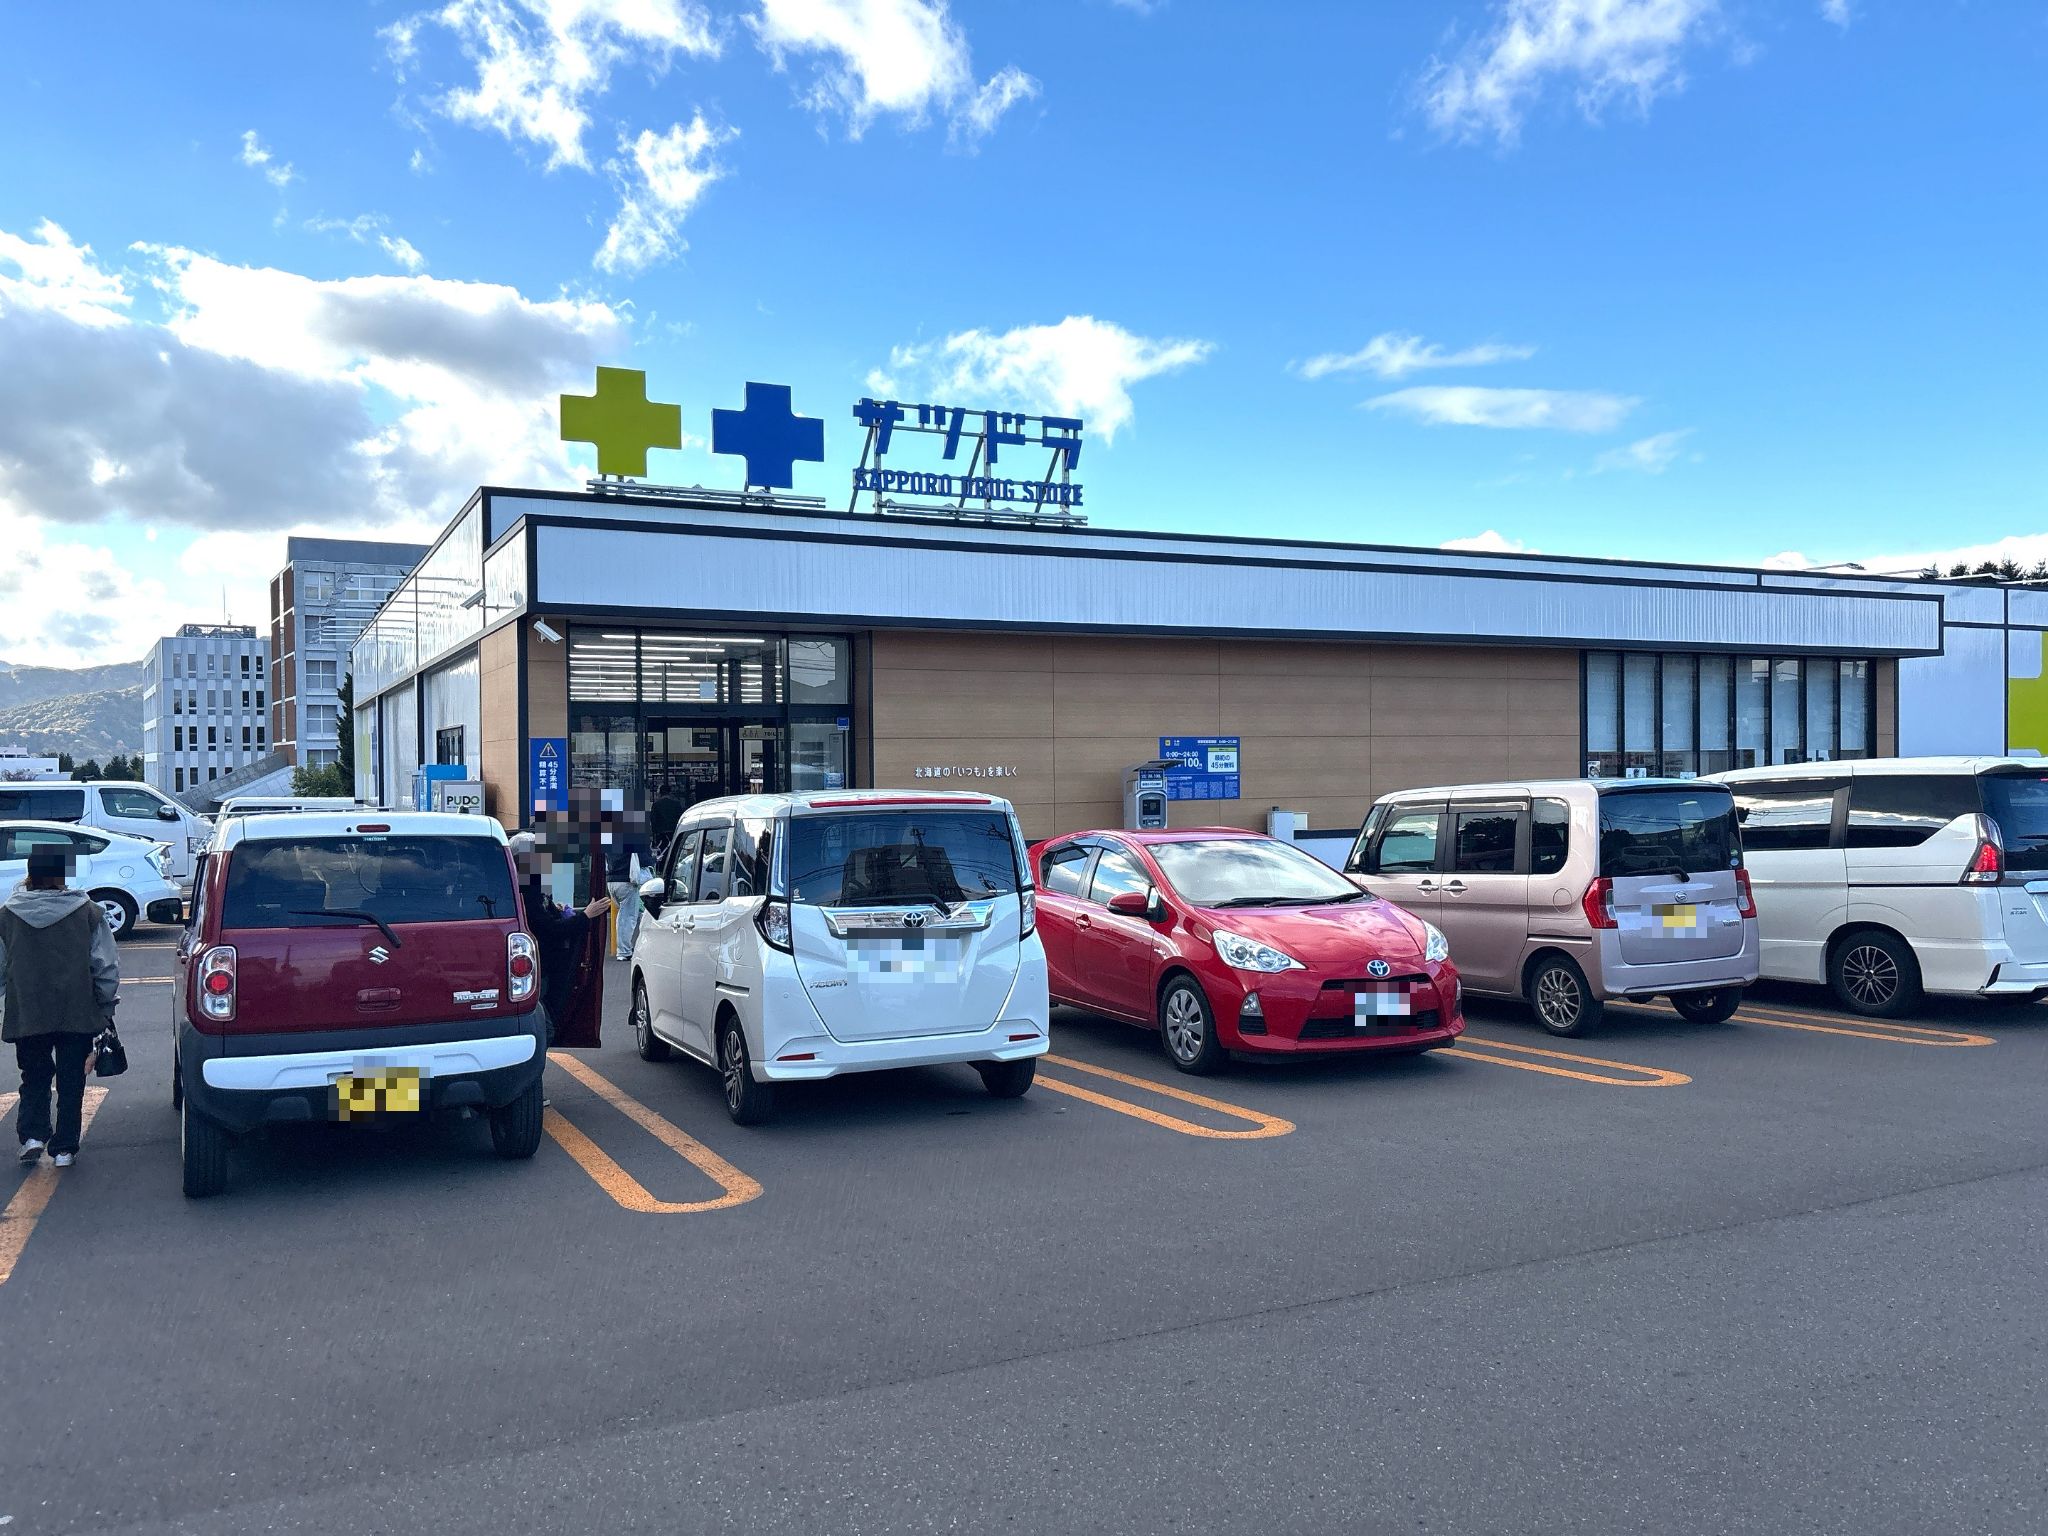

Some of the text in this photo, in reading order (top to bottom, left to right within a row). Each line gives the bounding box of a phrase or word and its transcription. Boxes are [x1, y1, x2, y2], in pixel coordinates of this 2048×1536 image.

[853, 397, 1084, 470] サツドラ
[855, 467, 1084, 506] SAPPORO DRUG STORE
[915, 766, 1018, 778] 北海道の「いつも」を楽しく
[446, 795, 480, 806] PUDO
